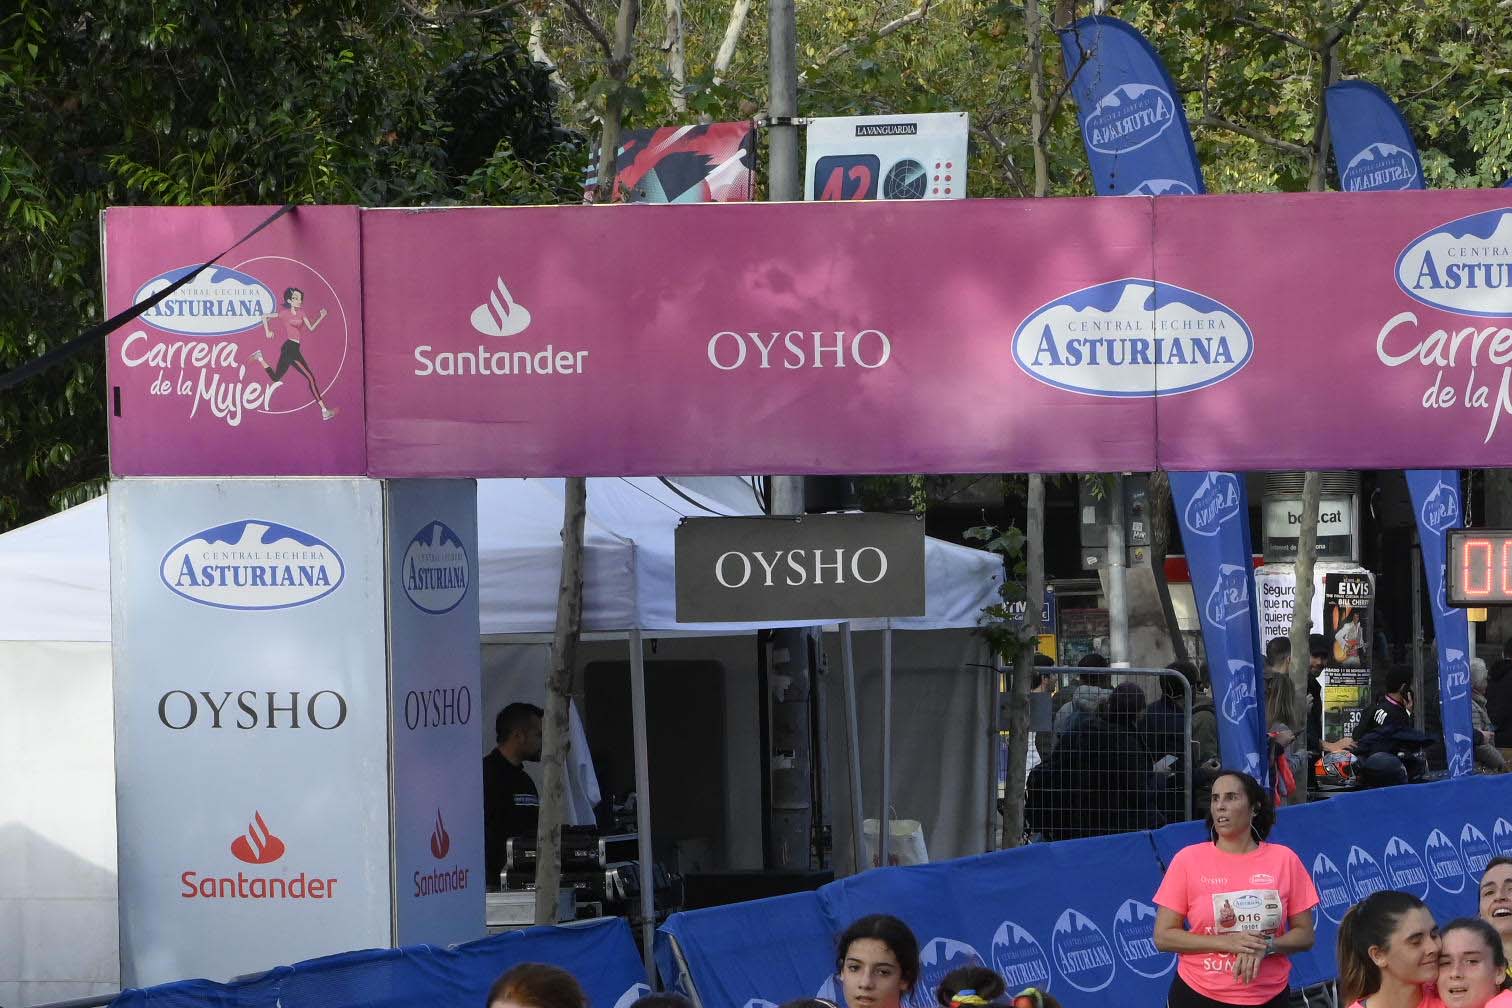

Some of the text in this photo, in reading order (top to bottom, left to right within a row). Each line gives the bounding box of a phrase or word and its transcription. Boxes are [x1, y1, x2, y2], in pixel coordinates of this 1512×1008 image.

[144, 290, 264, 317] ASTURIANA
[173, 288, 210, 296] ENTRAL
[1067, 318, 1226, 332] CENTRAL LECHERA
[121, 330, 240, 368] Carrera
[414, 344, 588, 377] Santander
[707, 329, 891, 370] OYSHO
[1031, 324, 1234, 366] ASTURIANA
[151, 369, 192, 396] de la
[190, 364, 283, 427] Mujer
[1422, 369, 1489, 408] de la
[1288, 510, 1342, 524] b.cat
[175, 553, 331, 588] ASTURIANA
[203, 550, 325, 560] CENTRAL LECHERA
[715, 546, 888, 588] OYSHO
[408, 554, 466, 591] ASTURIANA
[1338, 582, 1369, 595] ELVIS
[1264, 600, 1280, 609] que
[157, 689, 348, 730] OYSHO
[405, 685, 471, 730] OYSHO
[180, 872, 338, 899] Santander
[414, 866, 470, 898] Santander
[1238, 913, 1261, 922] 016
[1060, 943, 1112, 975] ASTURIANA
[1121, 931, 1159, 962] ASTUR
